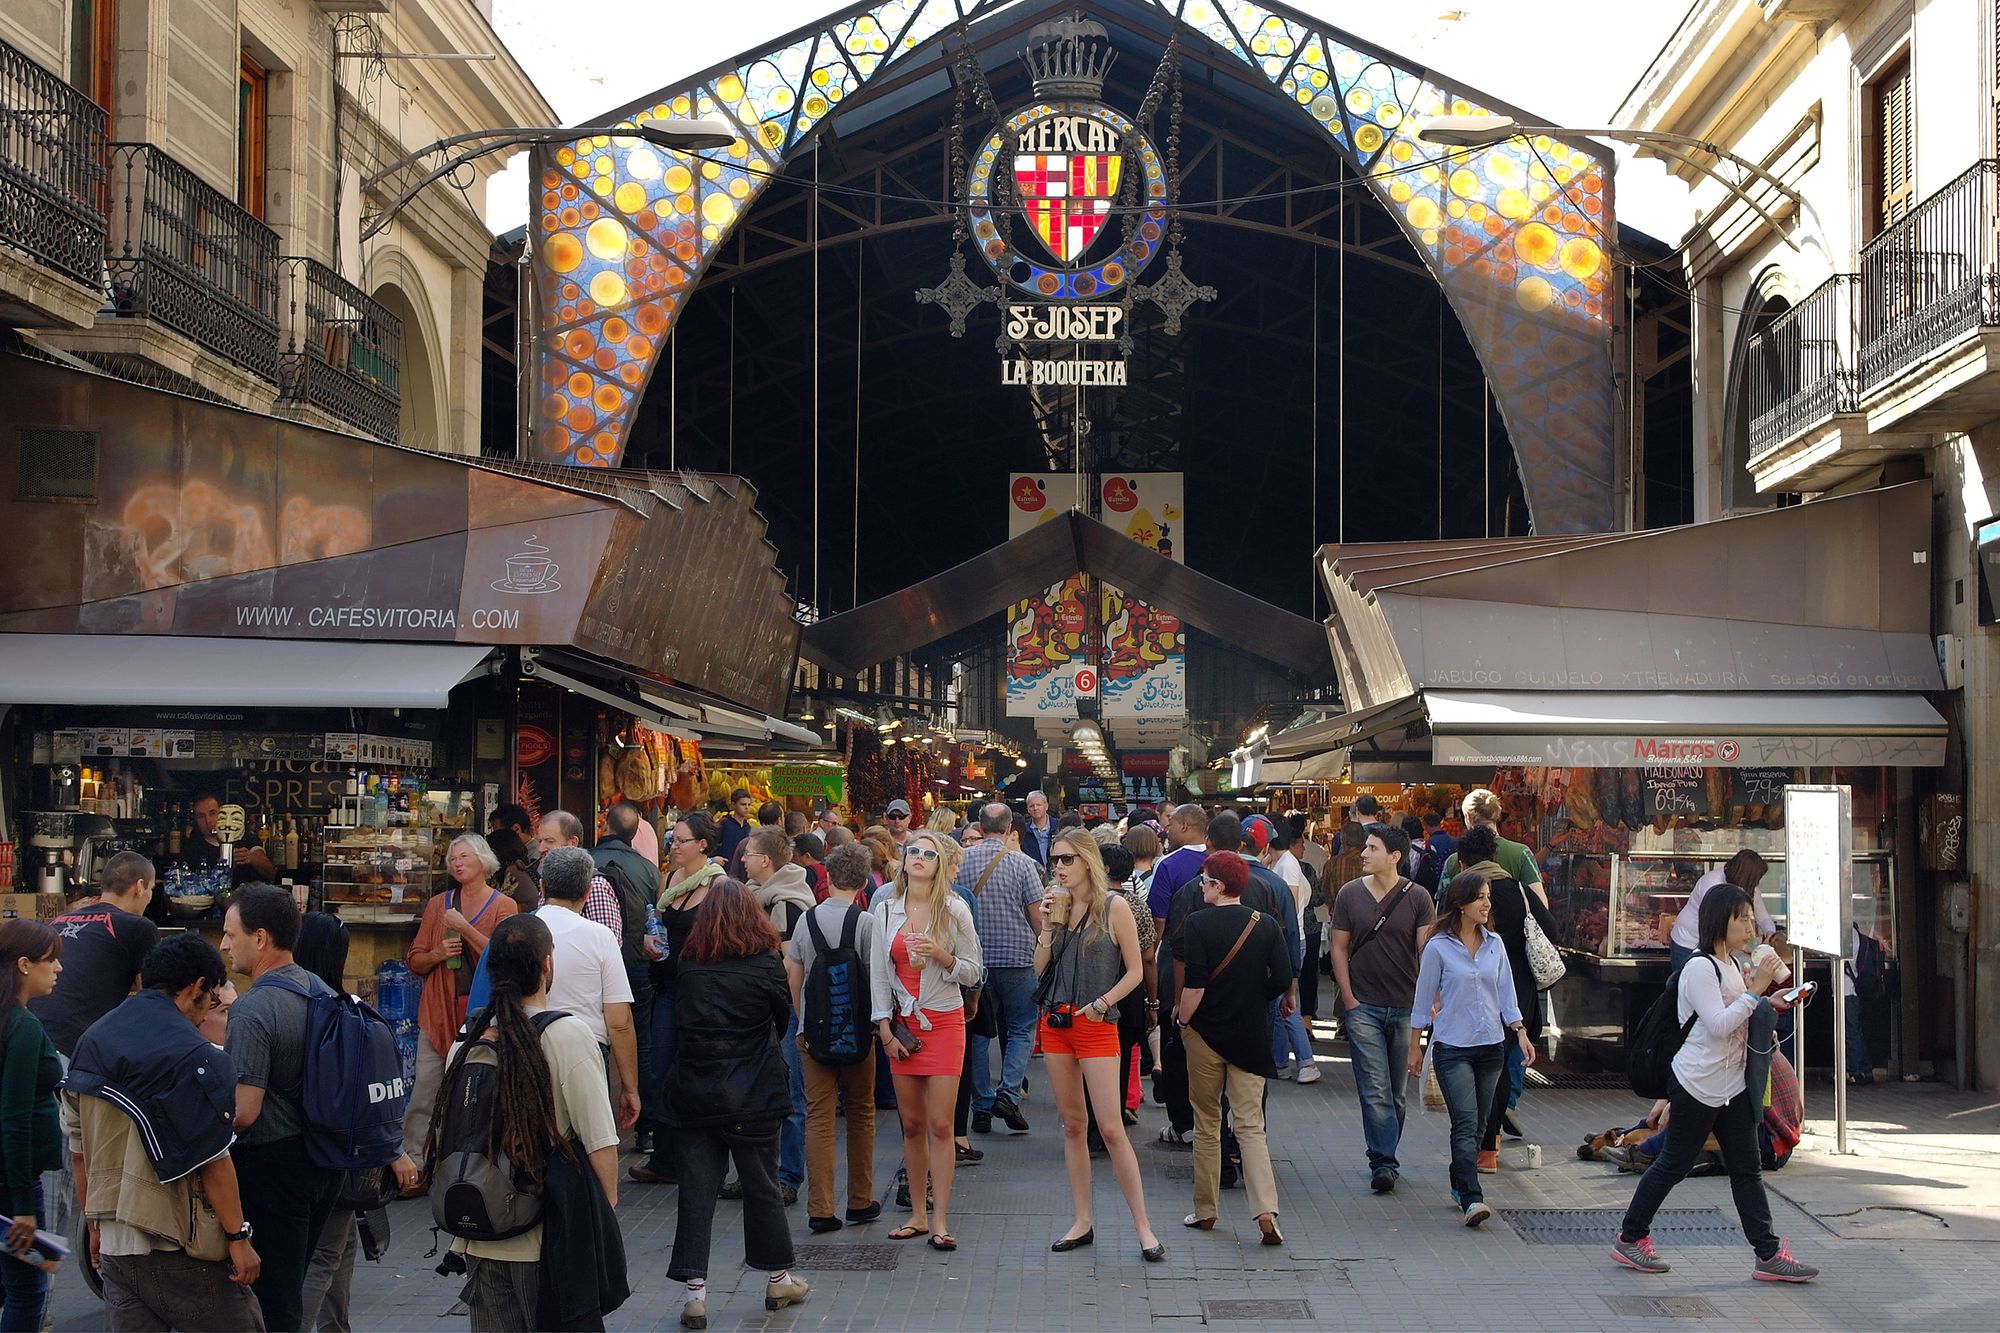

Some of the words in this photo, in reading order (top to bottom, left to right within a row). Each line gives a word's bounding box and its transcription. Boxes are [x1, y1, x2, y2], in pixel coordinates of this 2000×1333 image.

[1018, 116, 1119, 152] MERCAT
[1033, 305, 1123, 340] JOSEP
[1002, 360, 1026, 386] LA
[1032, 360, 1127, 386] BOQUERIA
[235, 606, 293, 626] WWW
[308, 607, 456, 628] CAFESVITORIA
[471, 609, 520, 629] COM
[1080, 673, 1090, 689] 6
[1429, 670, 1502, 684] JABUGO
[156, 712, 244, 721] www.cafesvitoria.com
[1634, 738, 1715, 759] Marcos
[1356, 786, 1375, 794] ONLY
